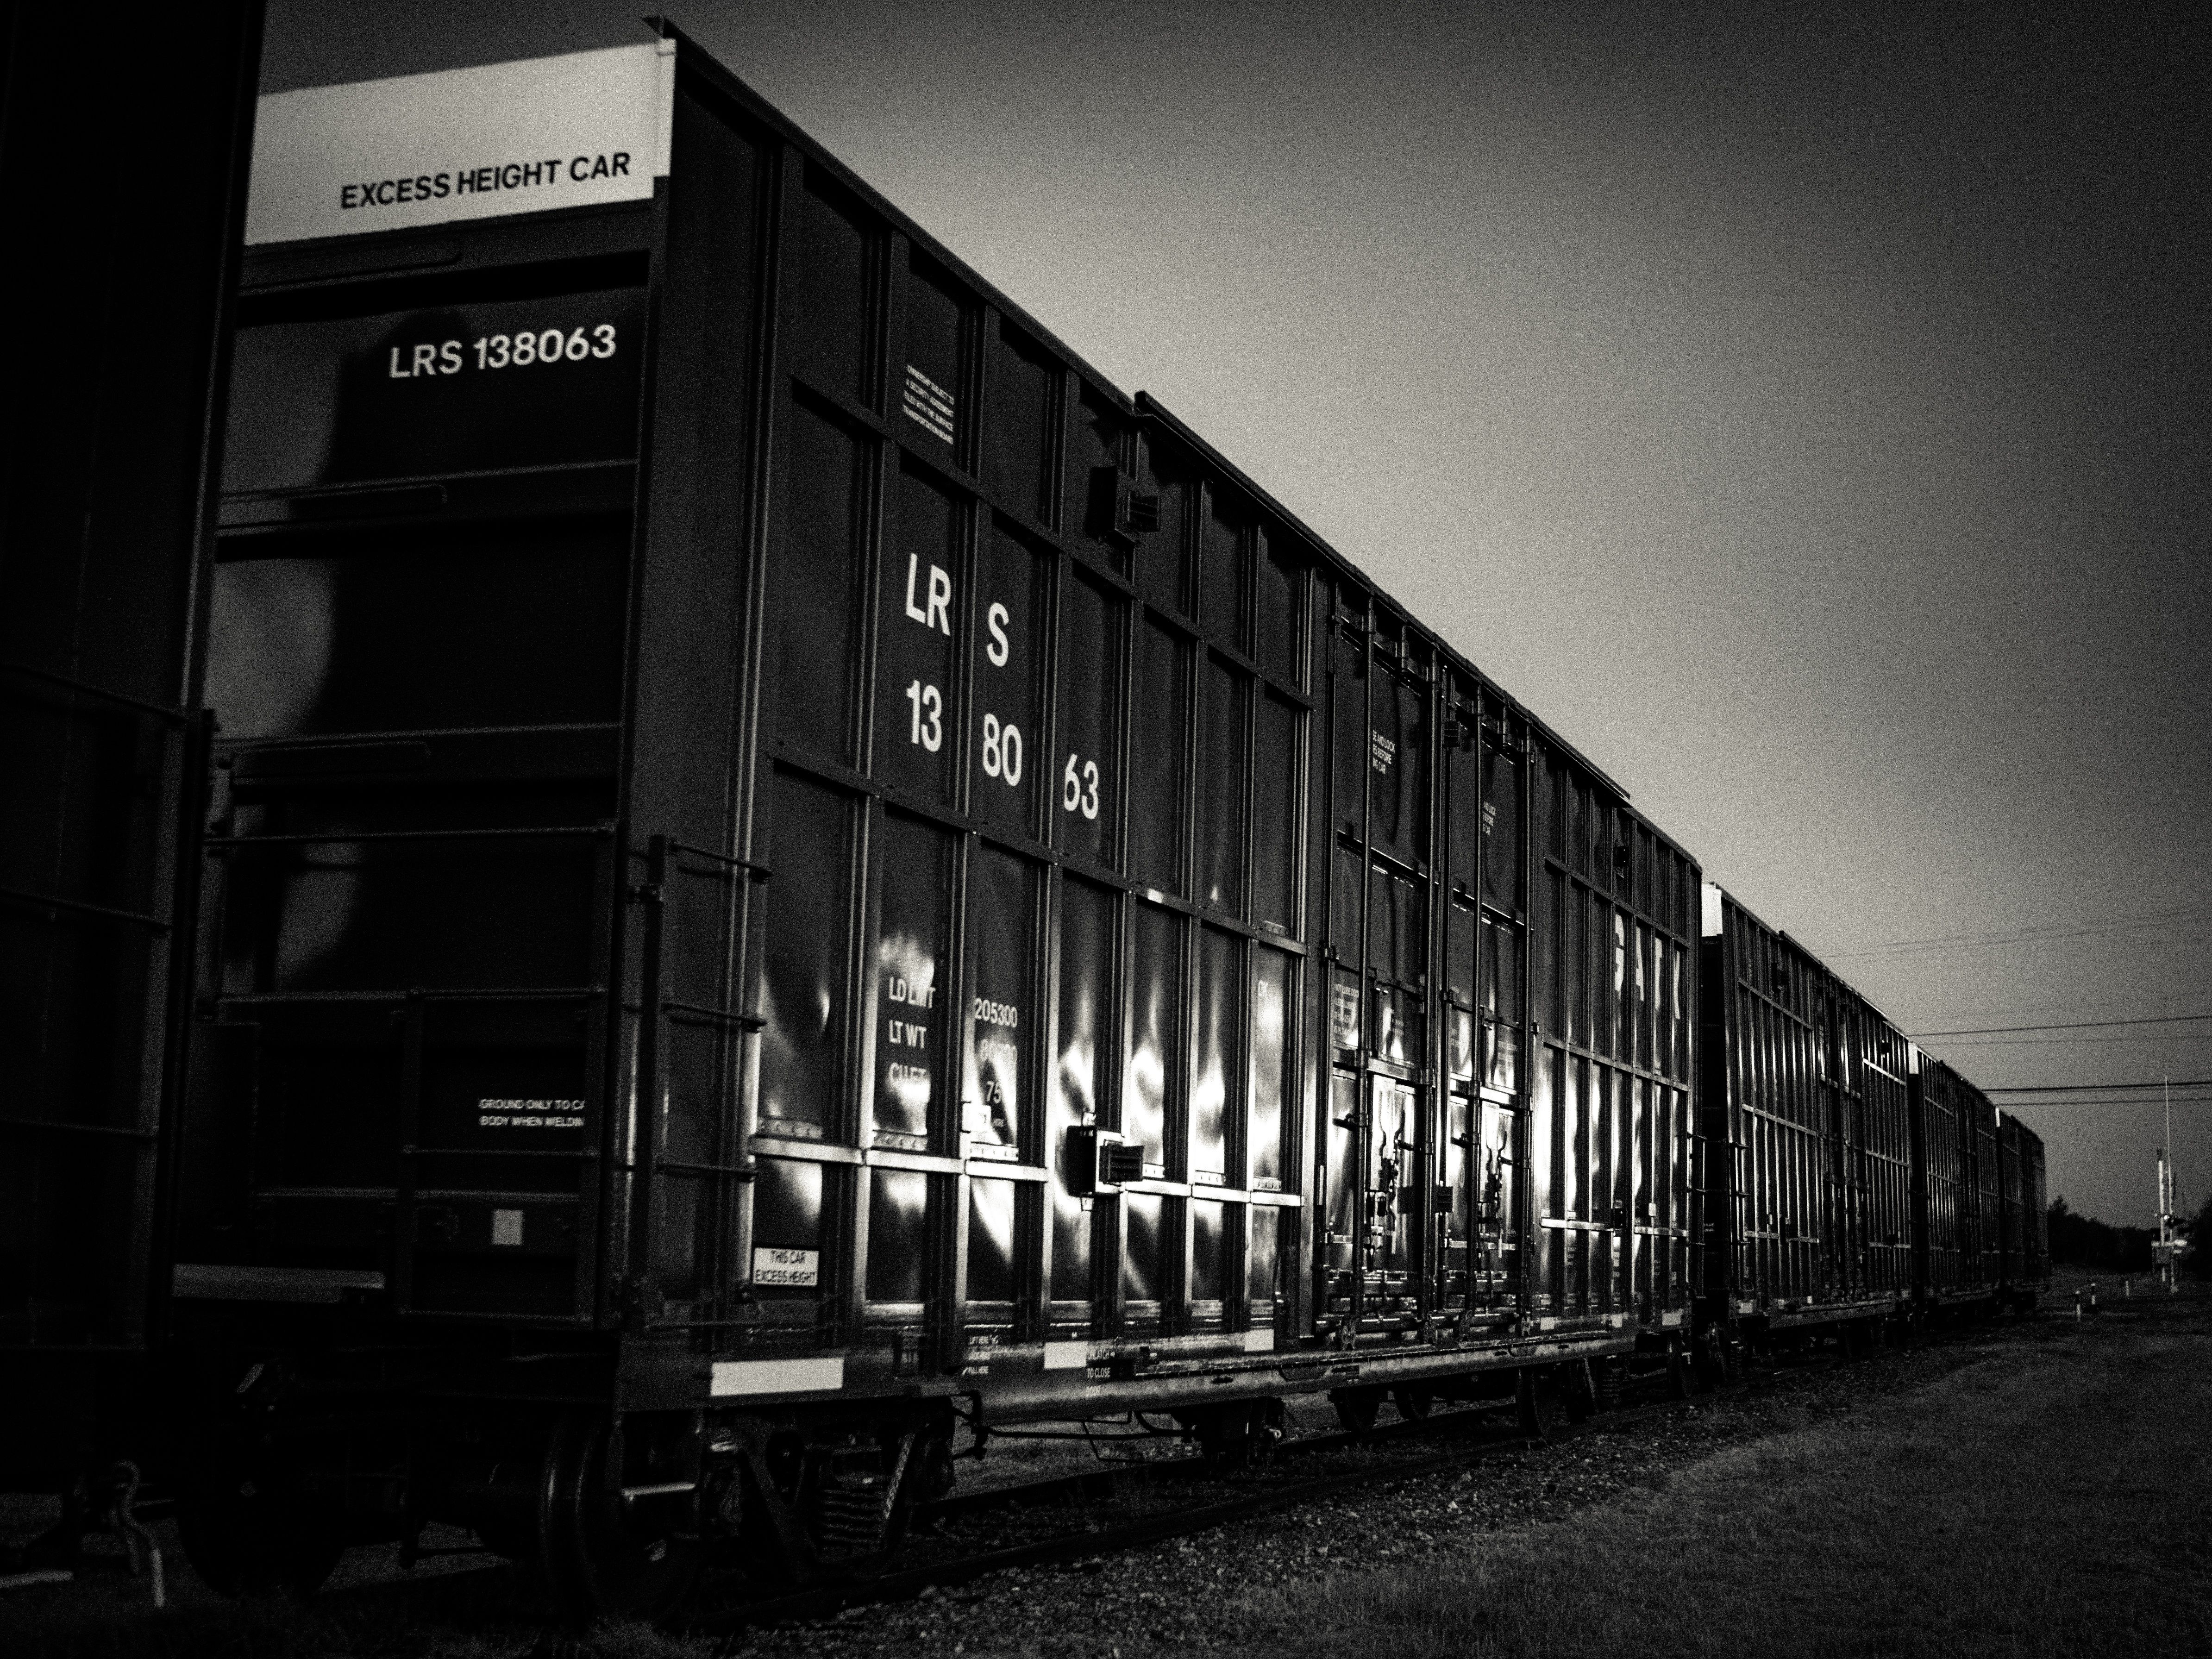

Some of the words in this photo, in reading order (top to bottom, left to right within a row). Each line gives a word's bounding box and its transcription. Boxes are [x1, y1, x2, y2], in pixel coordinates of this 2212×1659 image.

[341, 174, 450, 209] EXCESS
[457, 160, 562, 195] HEIGHT
[570, 152, 630, 182] CAR
[389, 340, 462, 378] LRS
[473, 324, 616, 369] 138063
[906, 553, 951, 636] LR
[986, 602, 1009, 667] S
[906, 680, 942, 752] 13
[983, 713, 1022, 787] 80
[1064, 754, 1098, 820] 63
[889, 977, 906, 1002] LD
[974, 998, 1018, 1028] 205300
[889, 1020, 903, 1044] LT
[905, 1023, 927, 1049] WT
[480, 1099, 524, 1109] GROUND
[526, 1099, 553, 1110] ONLY
[554, 1100, 570, 1110] TO
[479, 1116, 509, 1126] BODY
[512, 1116, 543, 1127] WHEN
[771, 1250, 788, 1264] THIS
[790, 1251, 806, 1264] CAR
[755, 1269, 787, 1283] EXCESS
[789, 1270, 817, 1283] HEIGHT
